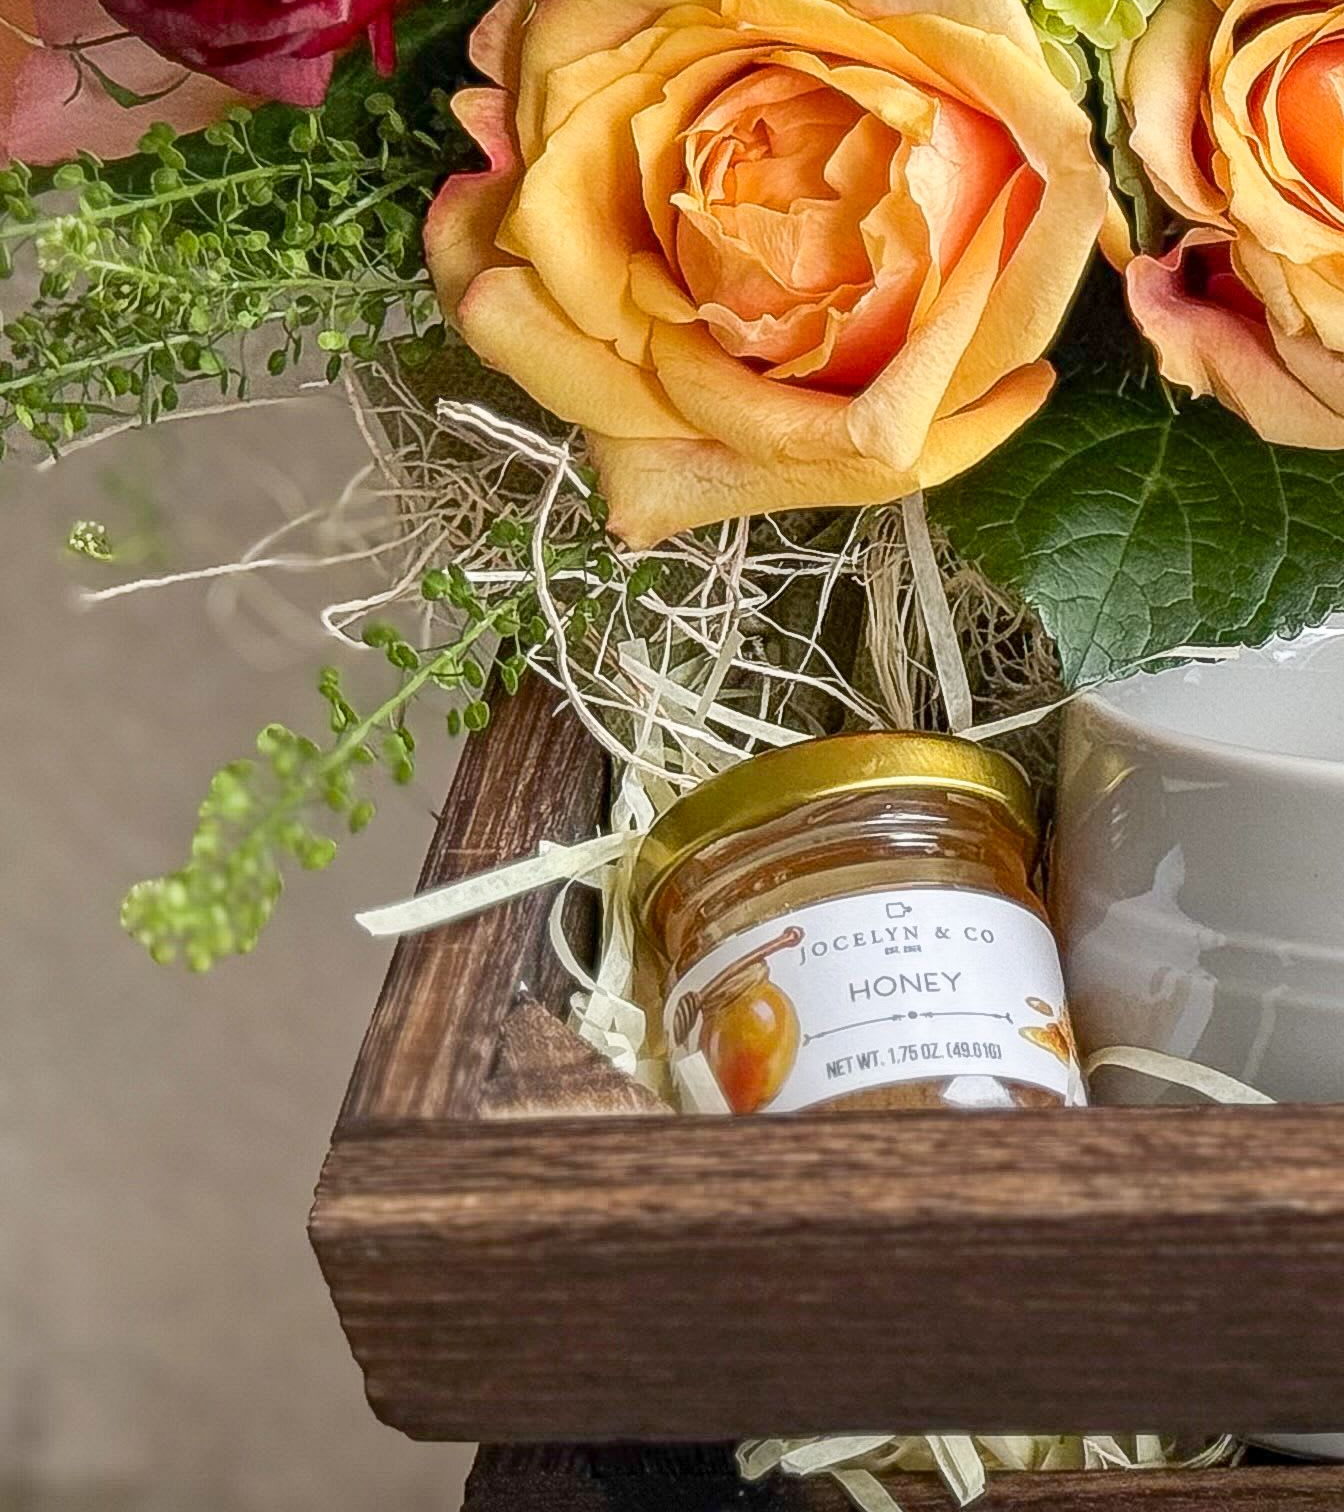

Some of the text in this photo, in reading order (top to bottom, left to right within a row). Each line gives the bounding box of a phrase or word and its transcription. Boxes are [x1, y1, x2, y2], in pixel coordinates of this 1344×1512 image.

[800, 925, 918, 966] JOCELYN
[935, 926, 951, 939] &
[964, 927, 994, 943] CO
[849, 972, 961, 1002] HONEY
[826, 1044, 918, 1080] NET WT. 1.75
